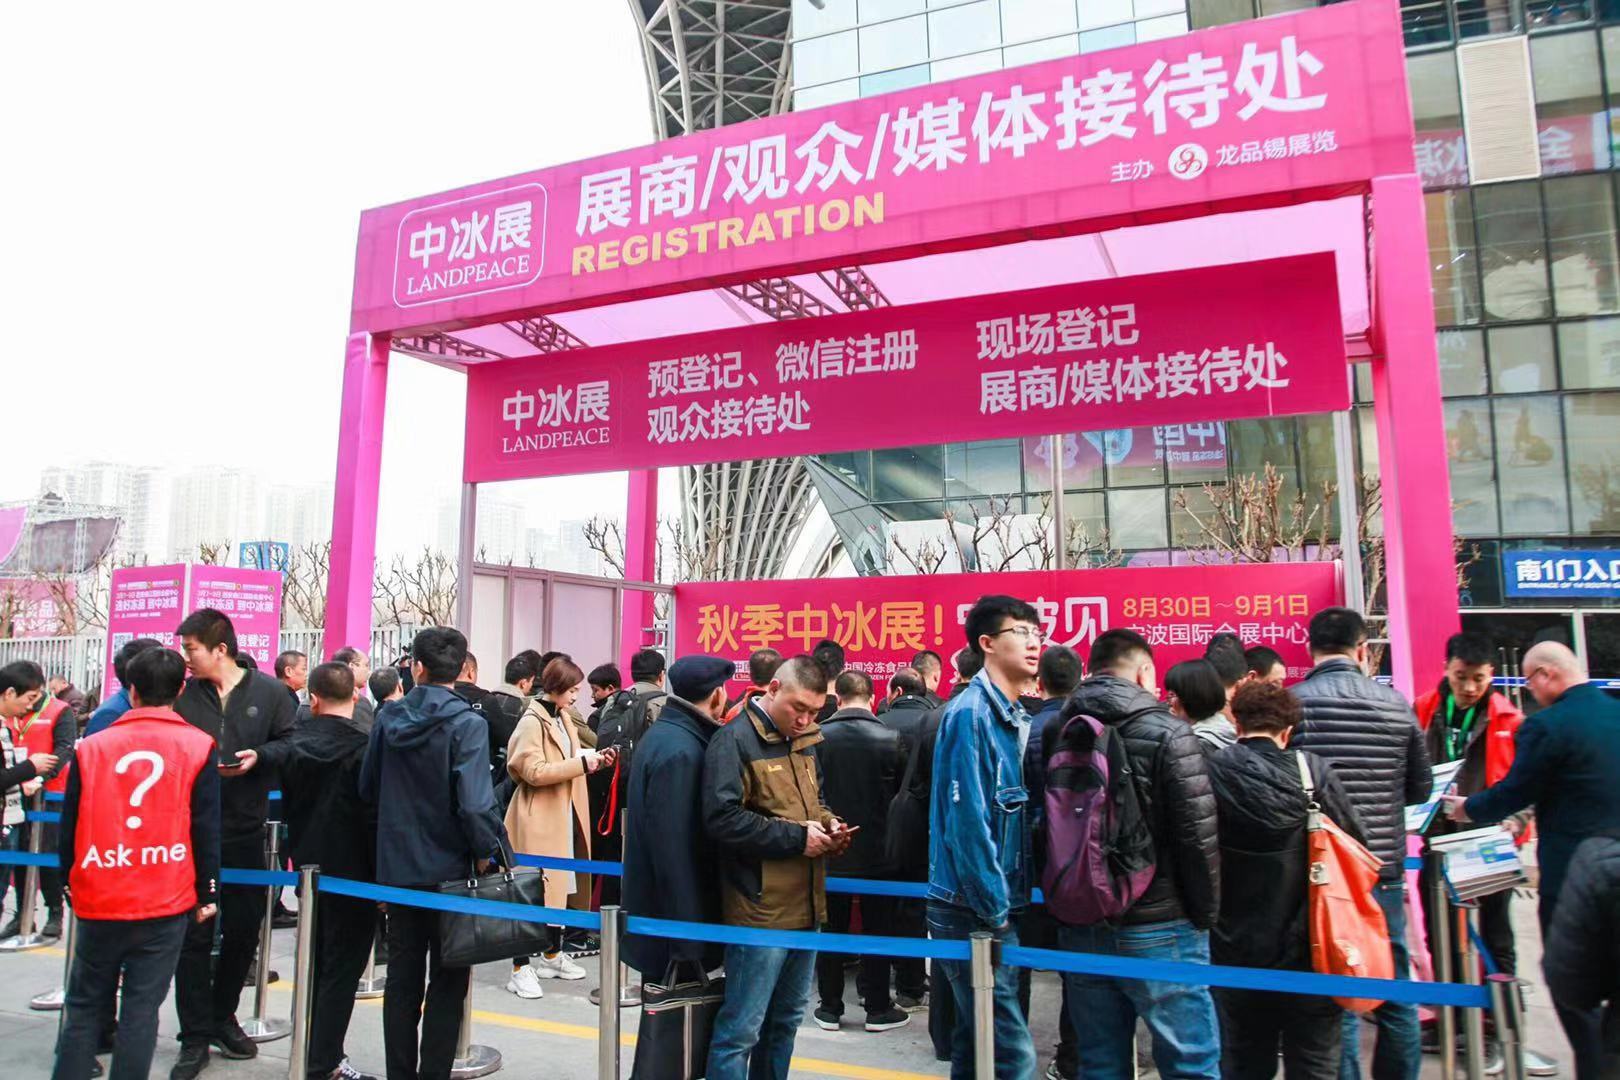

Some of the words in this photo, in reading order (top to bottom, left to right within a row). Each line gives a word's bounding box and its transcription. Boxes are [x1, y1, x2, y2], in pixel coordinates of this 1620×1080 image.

[575, 36, 1327, 238] 展商/观众/媒体接待处
[1215, 130, 1338, 167] 龙品锡展览
[1110, 159, 1154, 183] 主办
[408, 200, 533, 268] 中冰展
[572, 191, 885, 275] REGISTRATION
[406, 254, 530, 295] LANDPEACE
[976, 303, 1140, 361] 现场登记
[647, 328, 919, 399] 预登记、微信注册
[979, 342, 1290, 415] 展商/媒体接待处
[502, 380, 611, 431] 中冰展
[647, 391, 811, 444] 观众接待处
[502, 427, 610, 453] LANDPEACE
[81, 843, 134, 869] Ask
[141, 843, 187, 866] me
